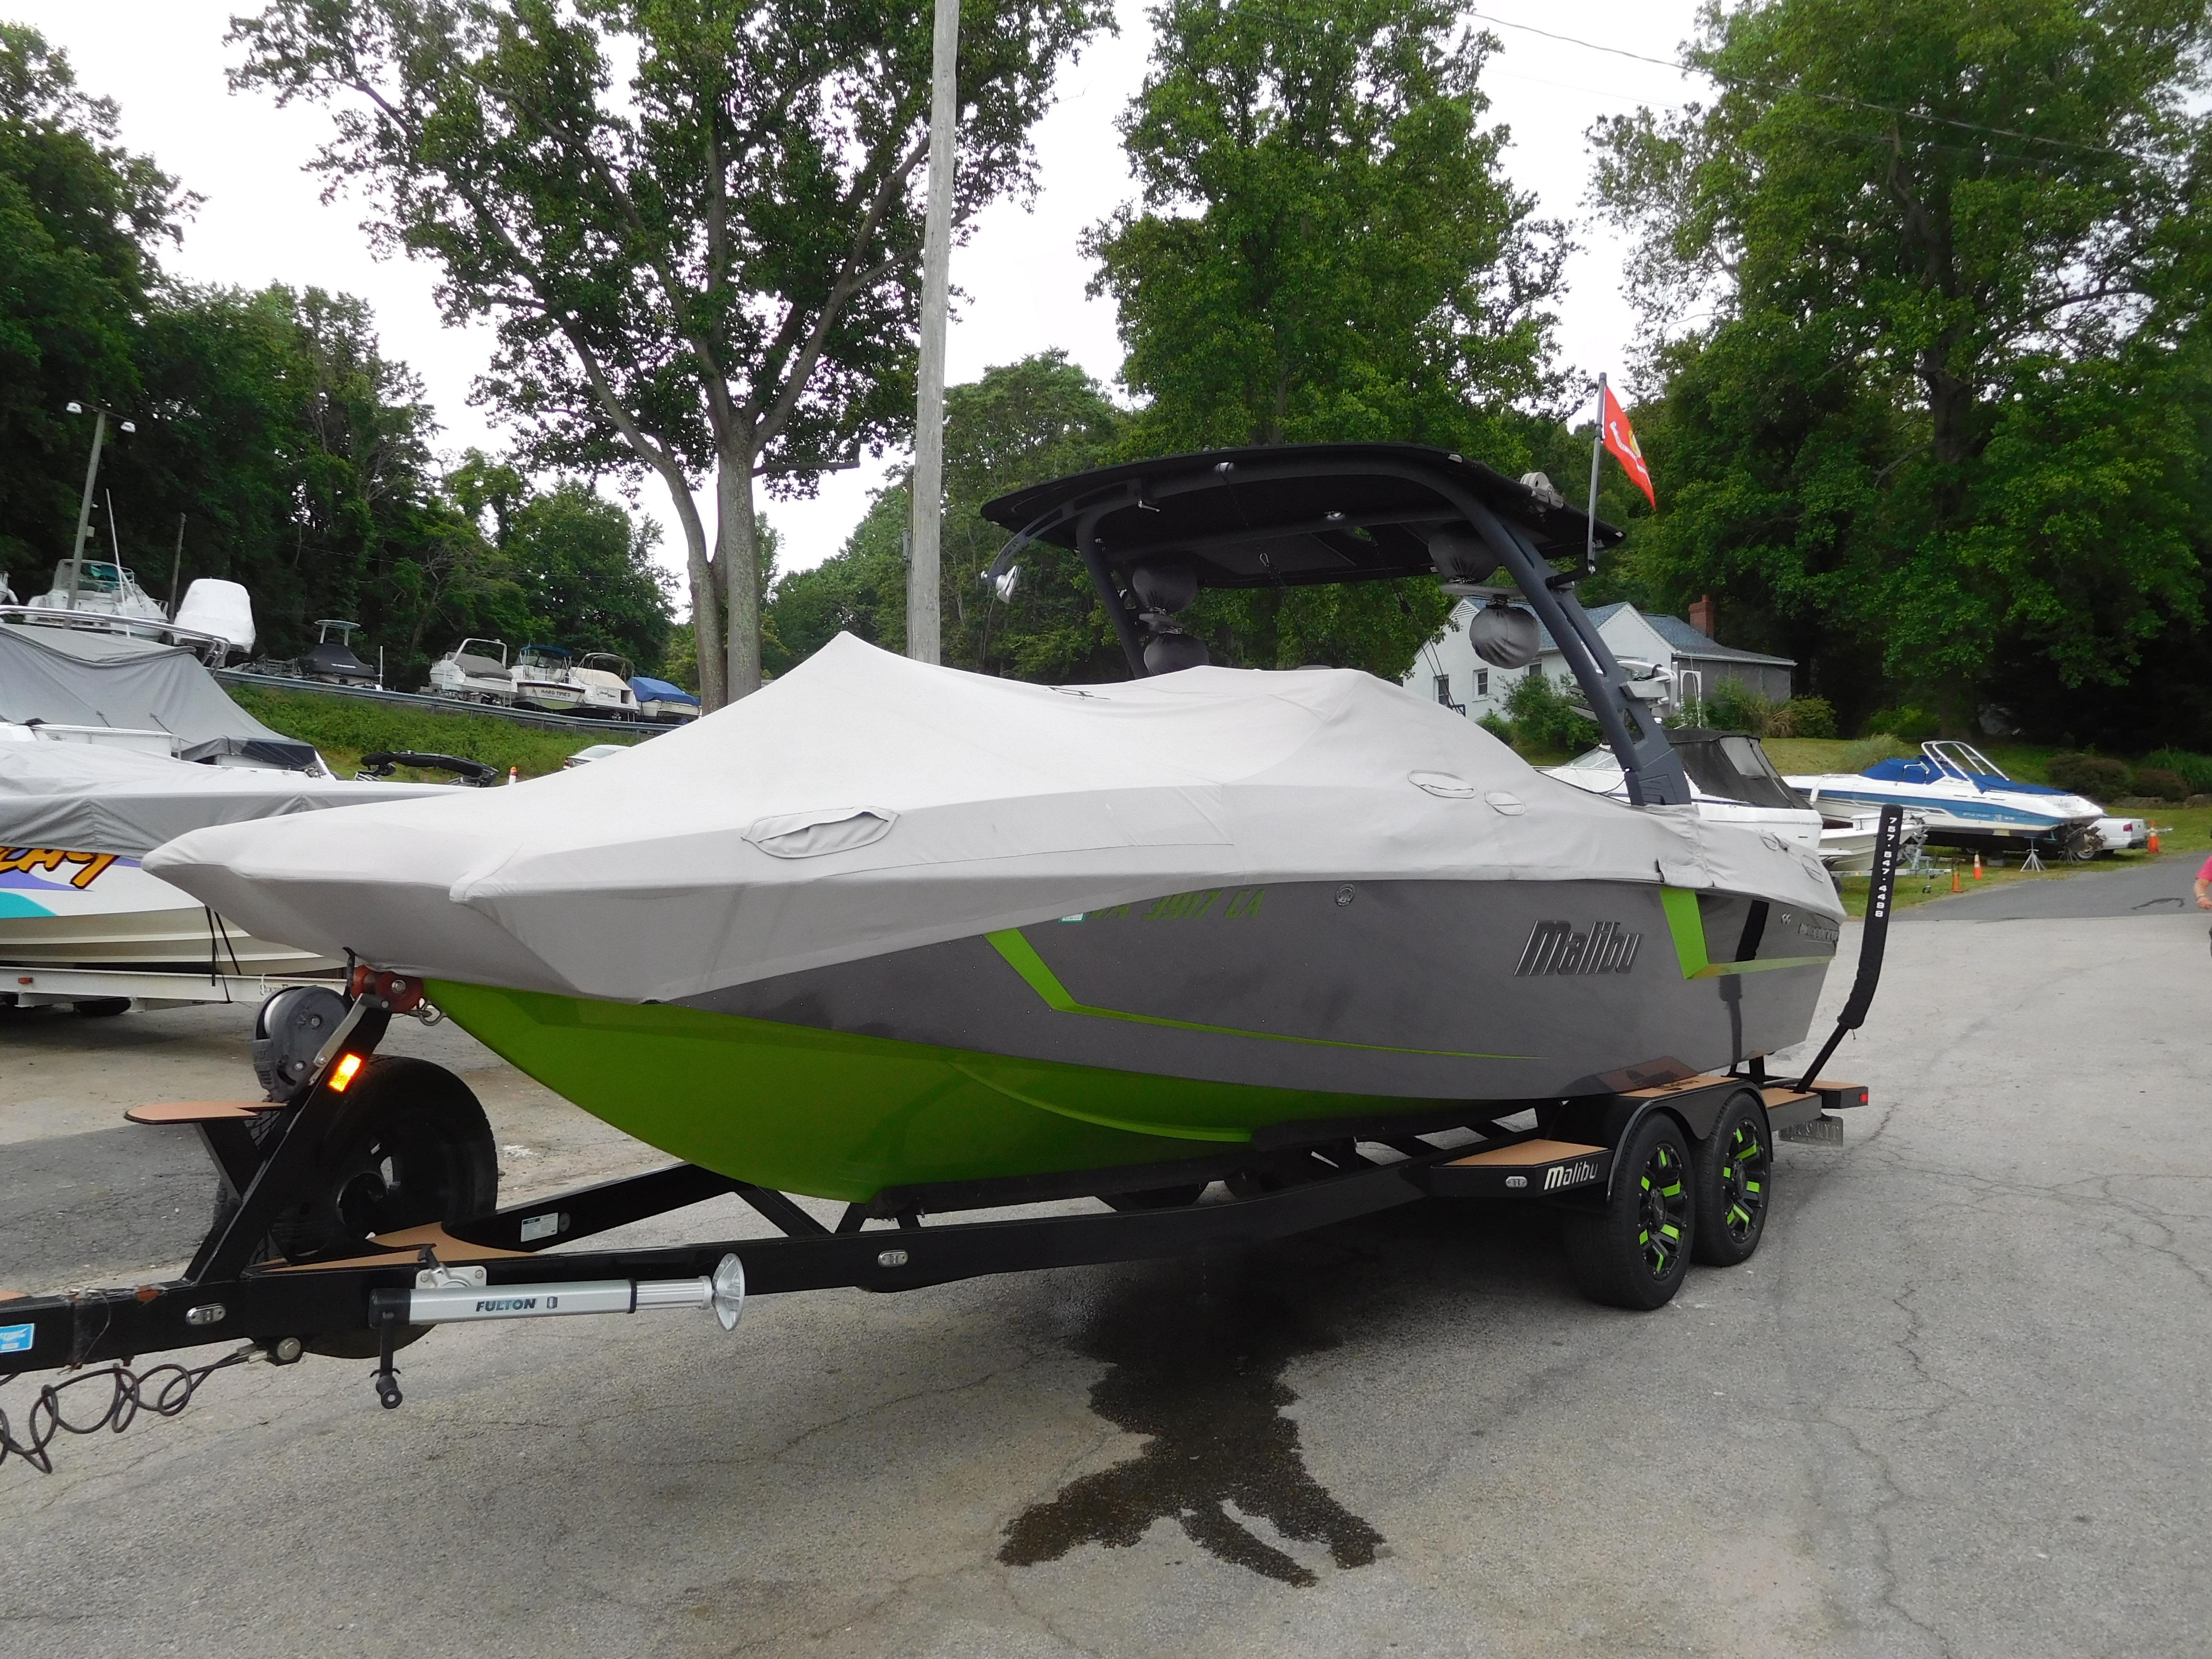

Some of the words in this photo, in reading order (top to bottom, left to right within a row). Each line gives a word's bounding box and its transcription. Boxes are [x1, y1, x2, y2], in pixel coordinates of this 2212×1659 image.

[1225, 889, 1266, 919] CA
[1514, 920, 1644, 976] Malibu
[1543, 1160, 1599, 1190] Malibu
[475, 1298, 537, 1312] FULTON
